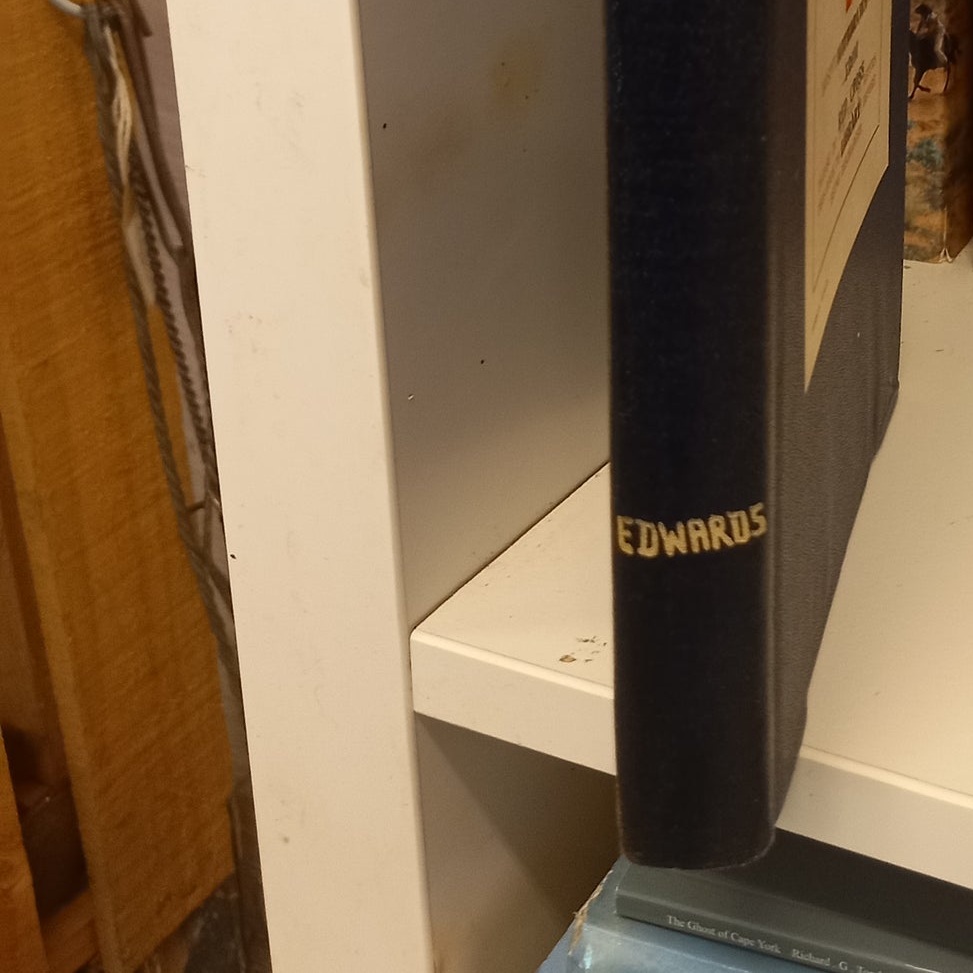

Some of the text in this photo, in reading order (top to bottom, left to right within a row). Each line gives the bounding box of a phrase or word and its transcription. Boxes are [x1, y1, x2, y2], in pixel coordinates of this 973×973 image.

[617, 502, 768, 557] EDWARDS
[667, 914, 685, 930] The
[687, 919, 715, 939] Ghost
[717, 929, 729, 939] of
[730, 931, 755, 948] Cape
[757, 938, 782, 955] York
[792, 948, 831, 967] Richard
